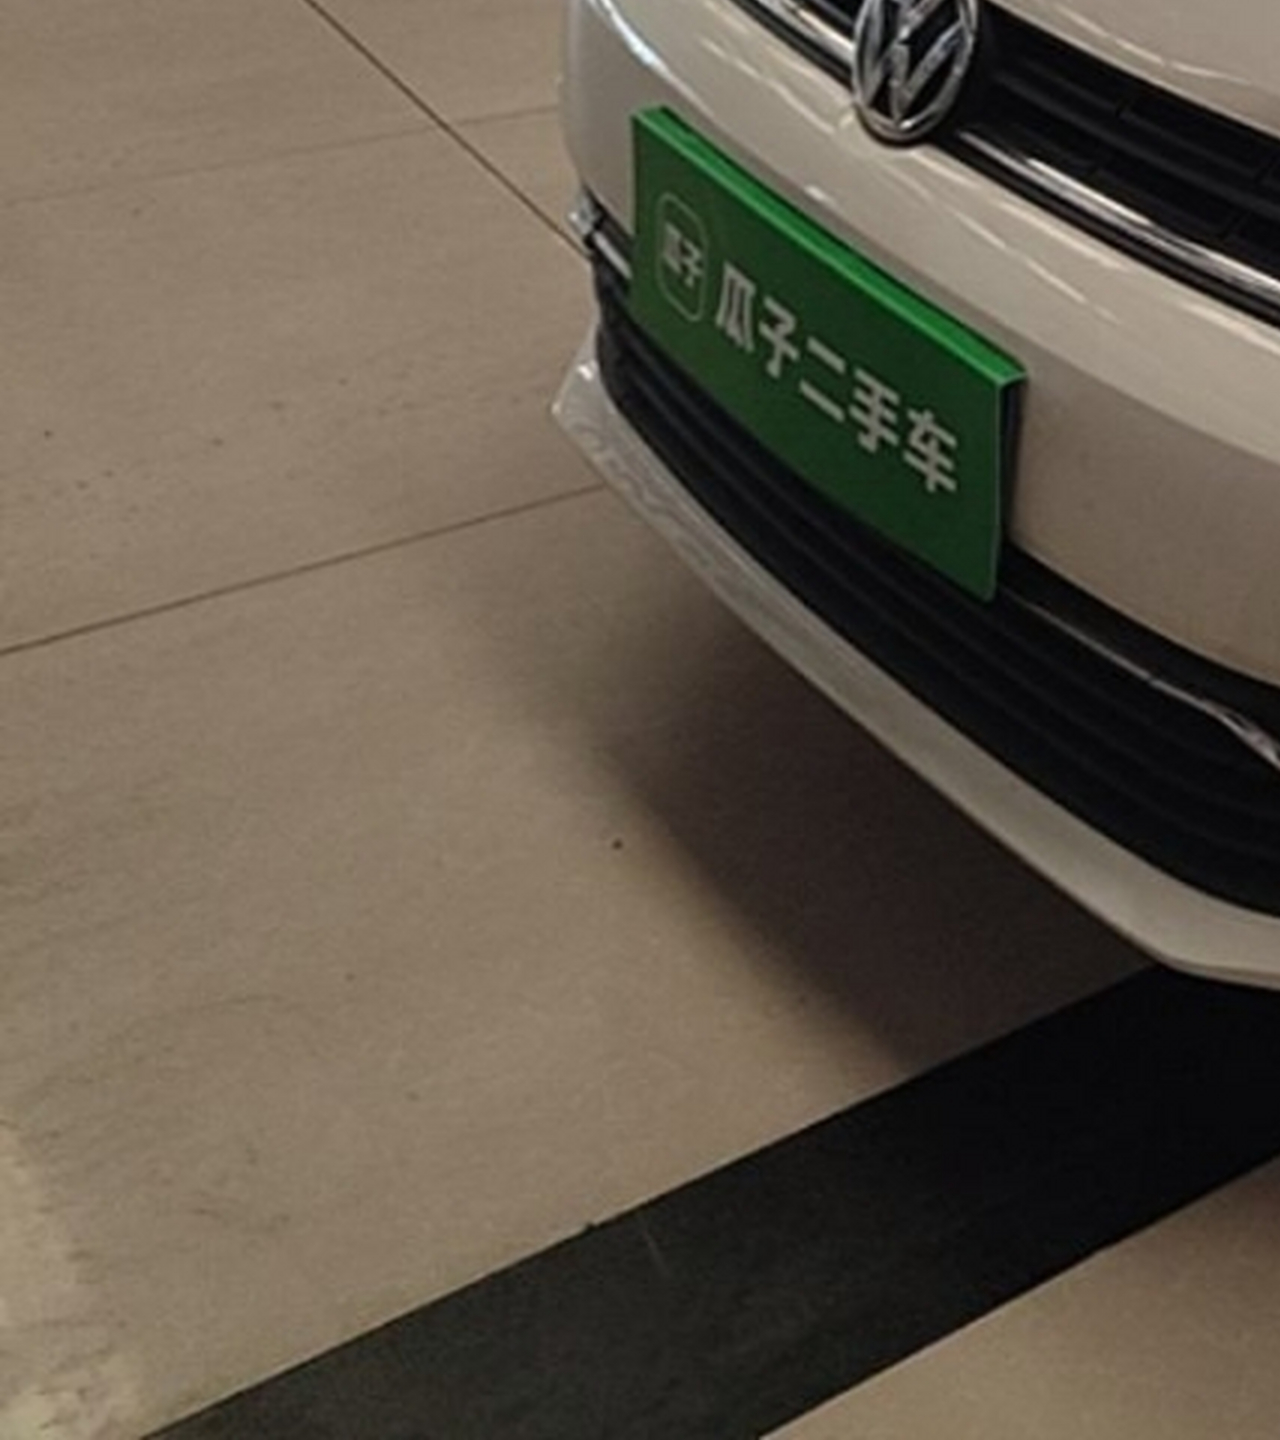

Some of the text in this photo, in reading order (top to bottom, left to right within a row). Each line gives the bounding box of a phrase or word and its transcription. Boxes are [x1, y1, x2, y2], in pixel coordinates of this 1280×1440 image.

[715, 259, 958, 494] 瓜子二手车
